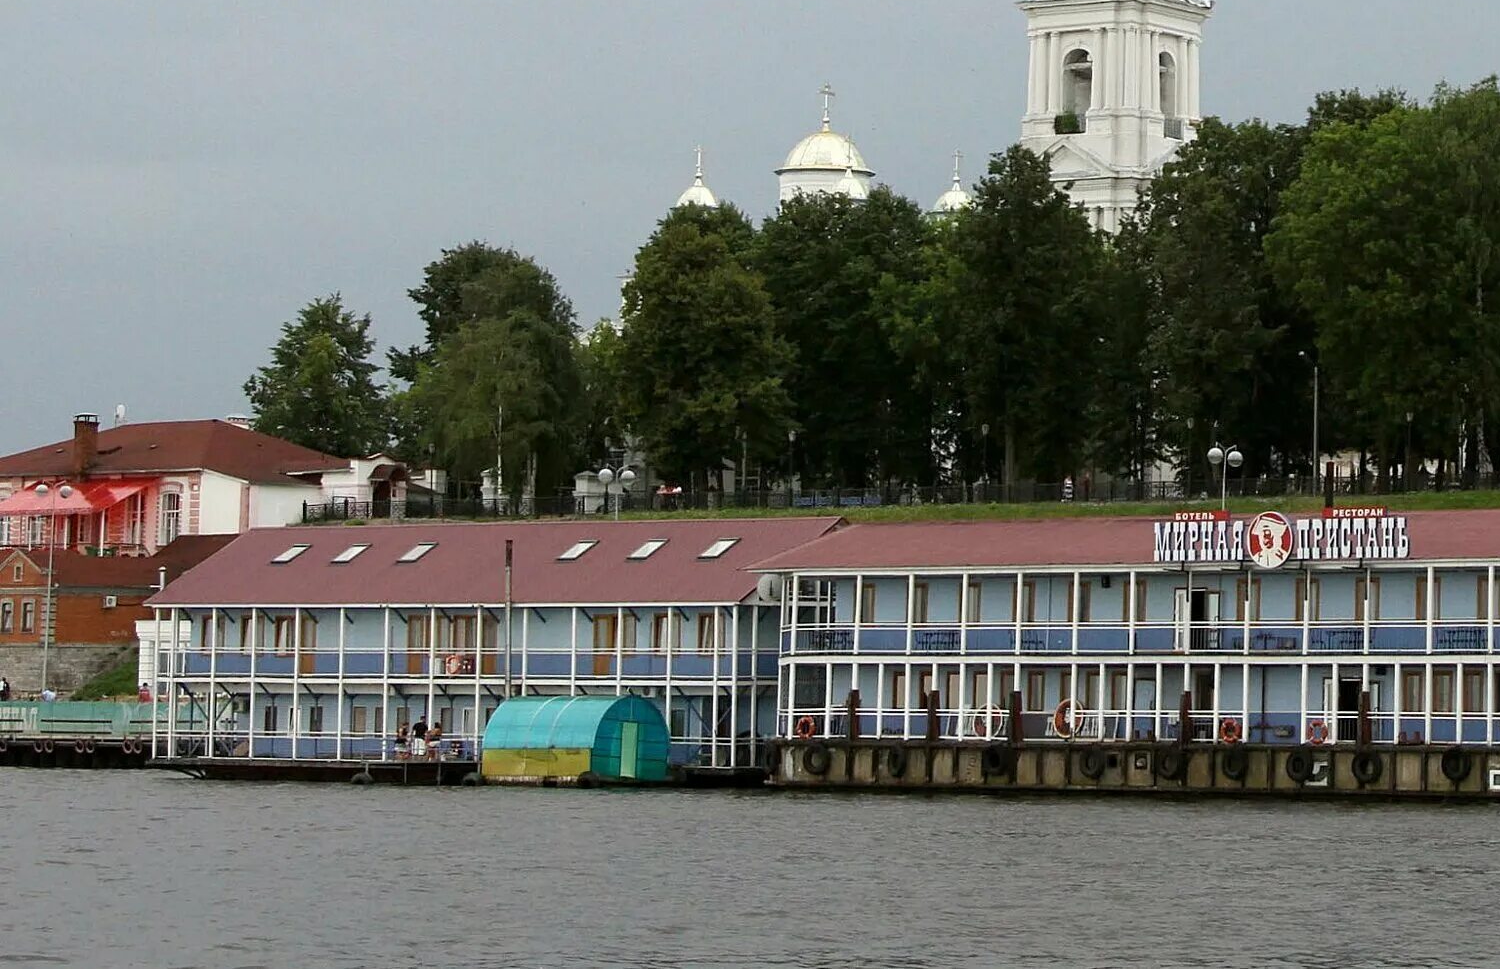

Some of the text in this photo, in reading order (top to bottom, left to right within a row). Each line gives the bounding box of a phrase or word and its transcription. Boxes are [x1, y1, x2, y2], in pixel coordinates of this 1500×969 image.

[1175, 512, 1215, 520] БОТЕЛЬ
[1332, 508, 1384, 517] РЕСТОРАН
[1153, 517, 1409, 562] МИРНАЯ ПРИСТАНЬ
